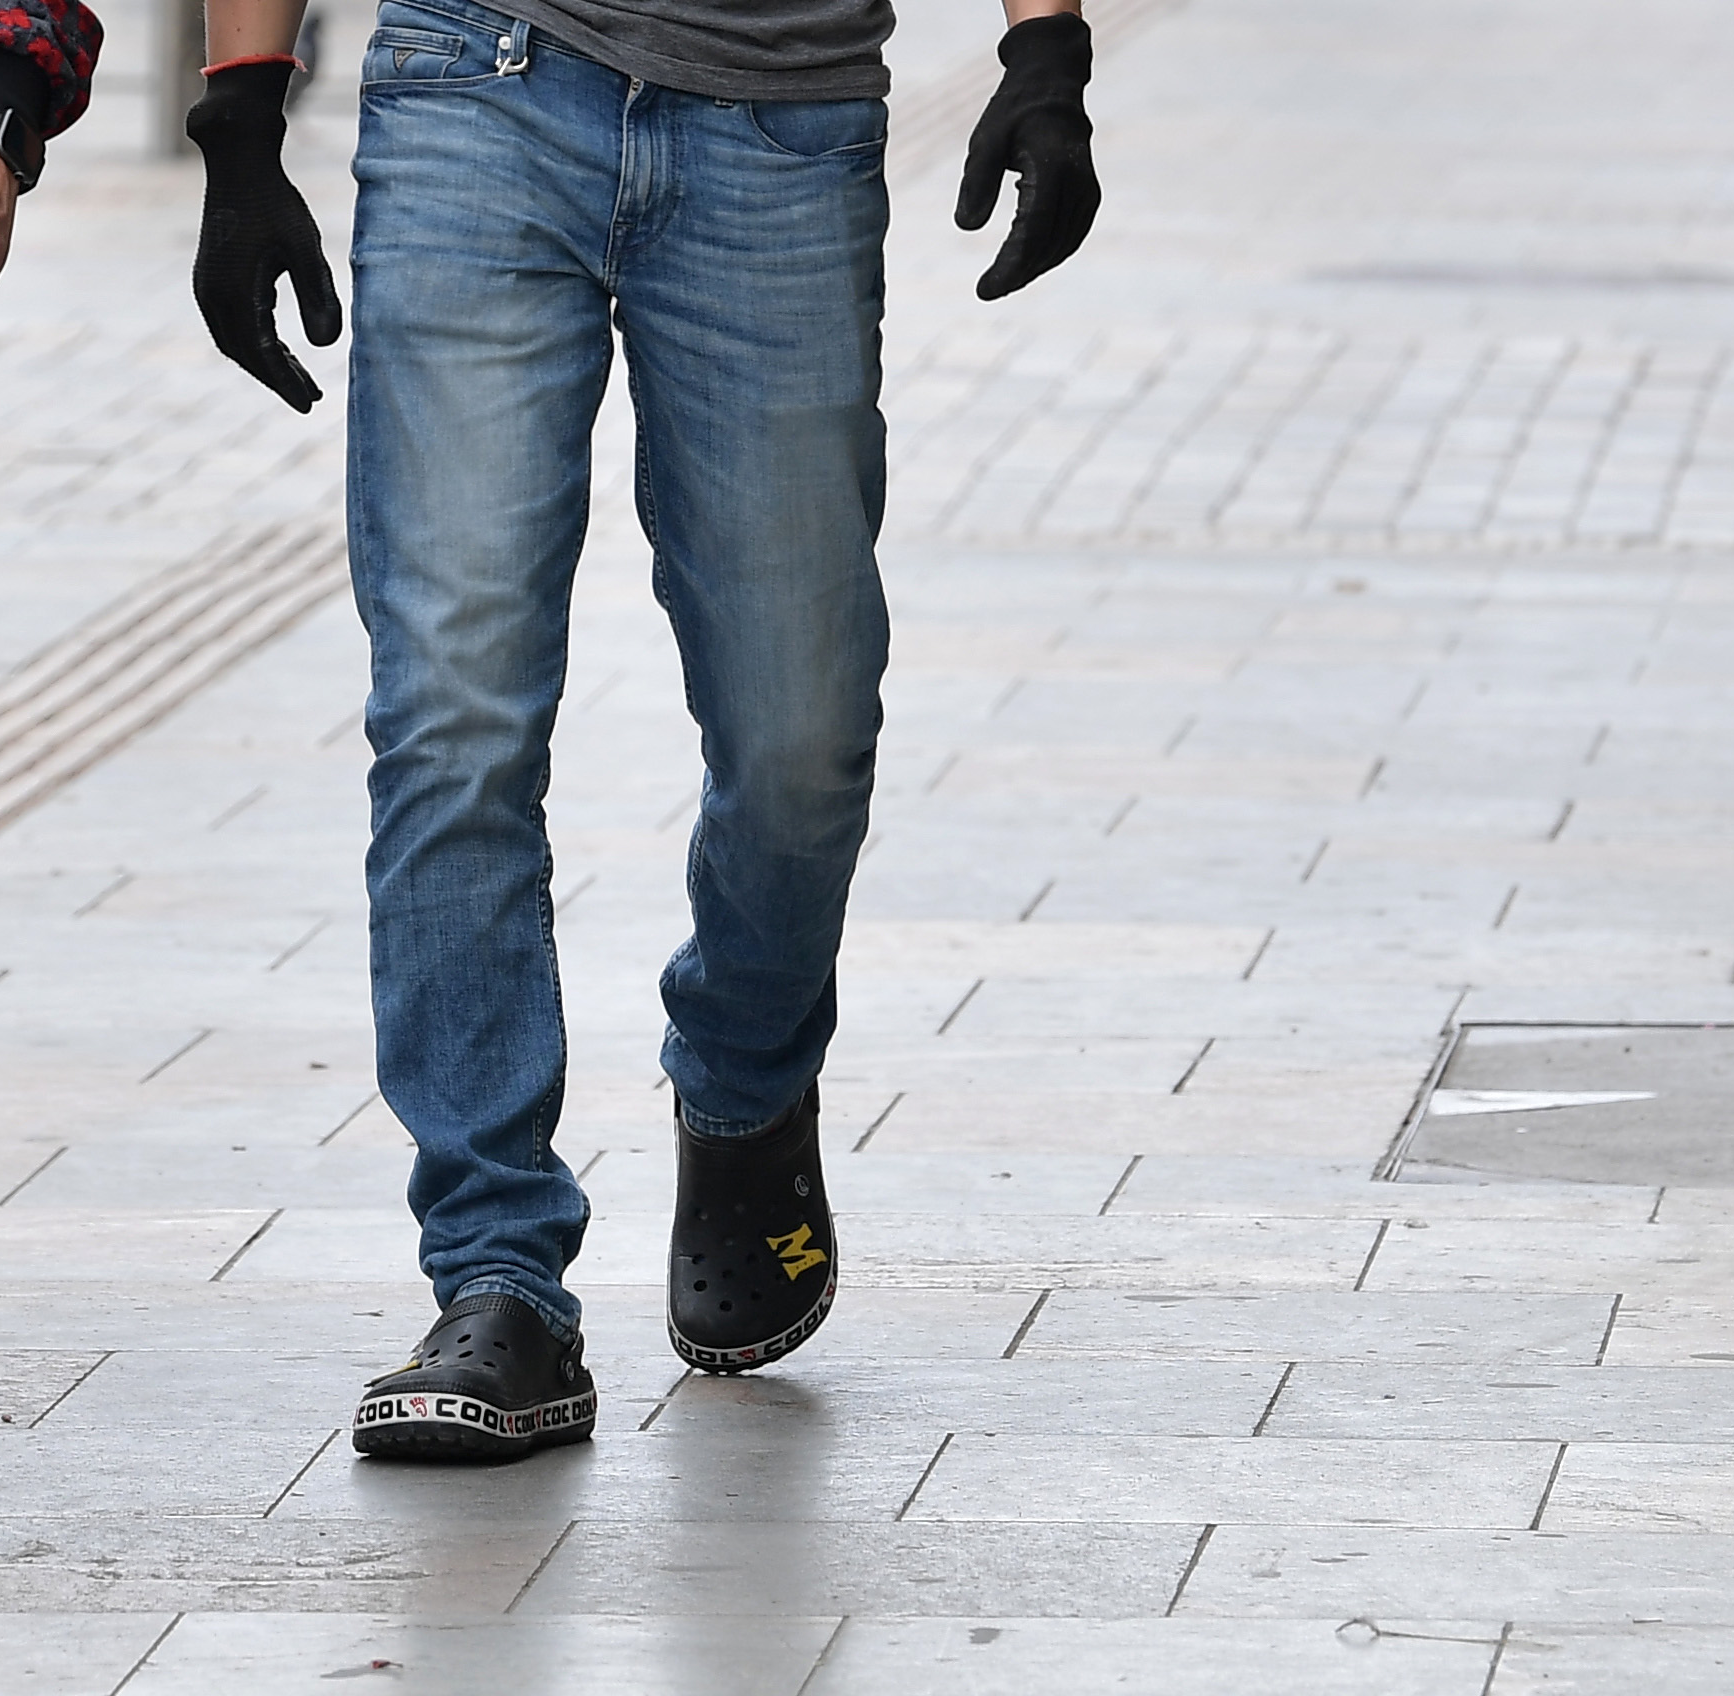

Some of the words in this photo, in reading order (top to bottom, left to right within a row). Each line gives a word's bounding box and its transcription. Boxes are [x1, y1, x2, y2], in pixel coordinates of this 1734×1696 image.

[766, 1223, 827, 1279] M
[764, 1302, 830, 1355] COOL
[356, 1399, 409, 1424] COOL
[435, 1398, 508, 1434] COOL
